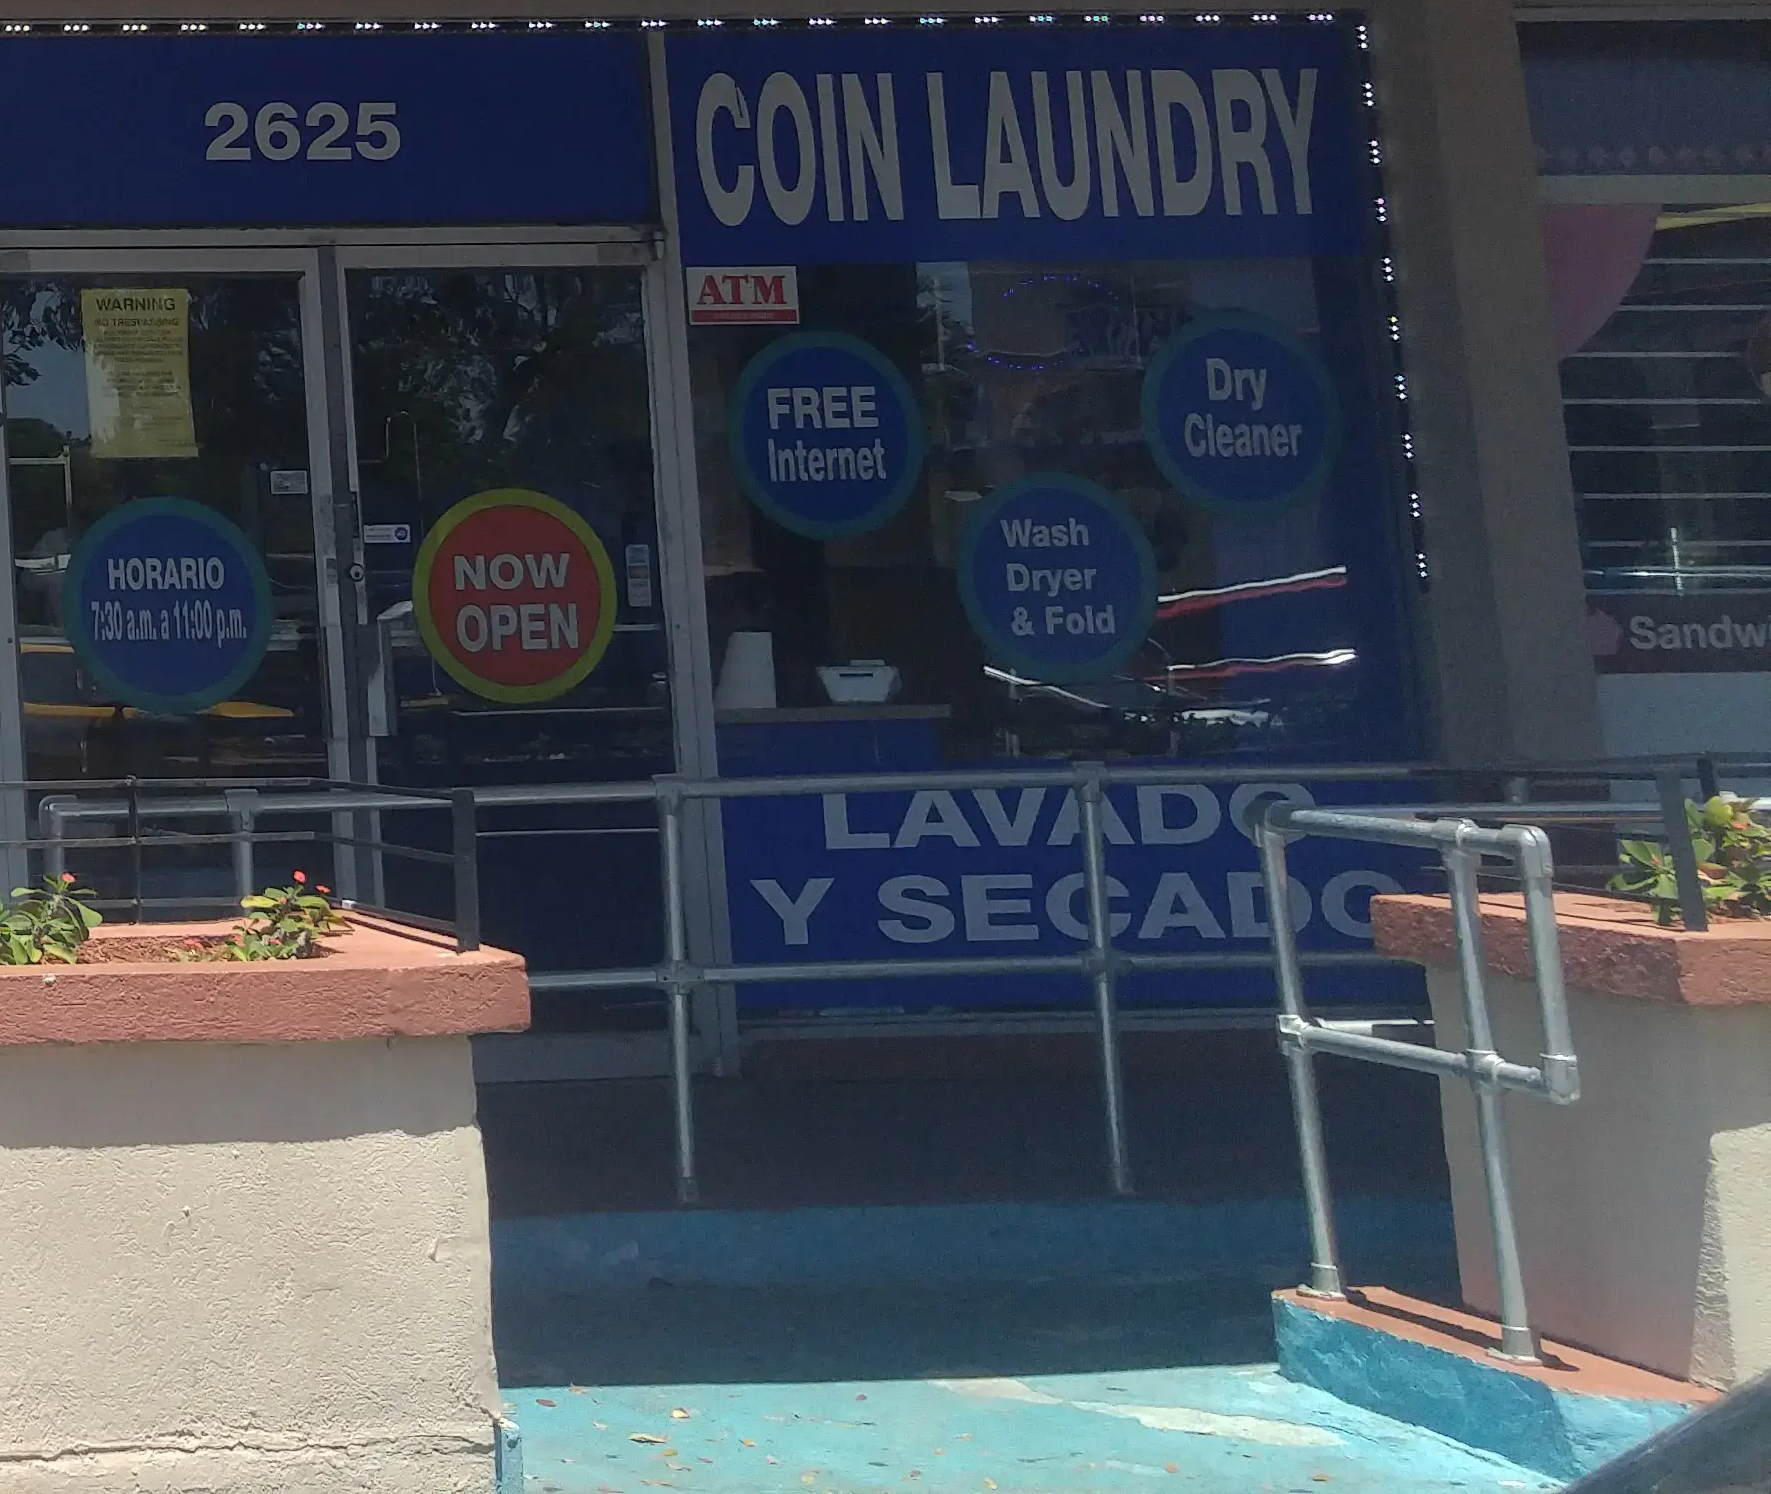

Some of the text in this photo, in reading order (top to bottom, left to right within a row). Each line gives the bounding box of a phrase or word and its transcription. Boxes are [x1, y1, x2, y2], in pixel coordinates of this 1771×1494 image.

[204, 101, 400, 161] 2625
[696, 68, 1318, 226] COIN LAUNDRY
[96, 297, 176, 312] WARNING
[696, 274, 787, 305] ATM
[1206, 357, 1267, 411] Dry
[767, 386, 879, 430] FREE
[1183, 415, 1302, 459] Cleaner
[768, 437, 886, 482] Internet
[1001, 518, 1090, 548] Wash
[107, 557, 225, 591] HORARIO
[454, 554, 570, 589] NOW
[1005, 562, 1097, 597] Dryer
[91, 600, 247, 648] 7:30 a.m. a 11:00 p.m.
[457, 604, 579, 650] OPEN
[1012, 605, 1116, 637] & Fold
[749, 877, 835, 946] Y
